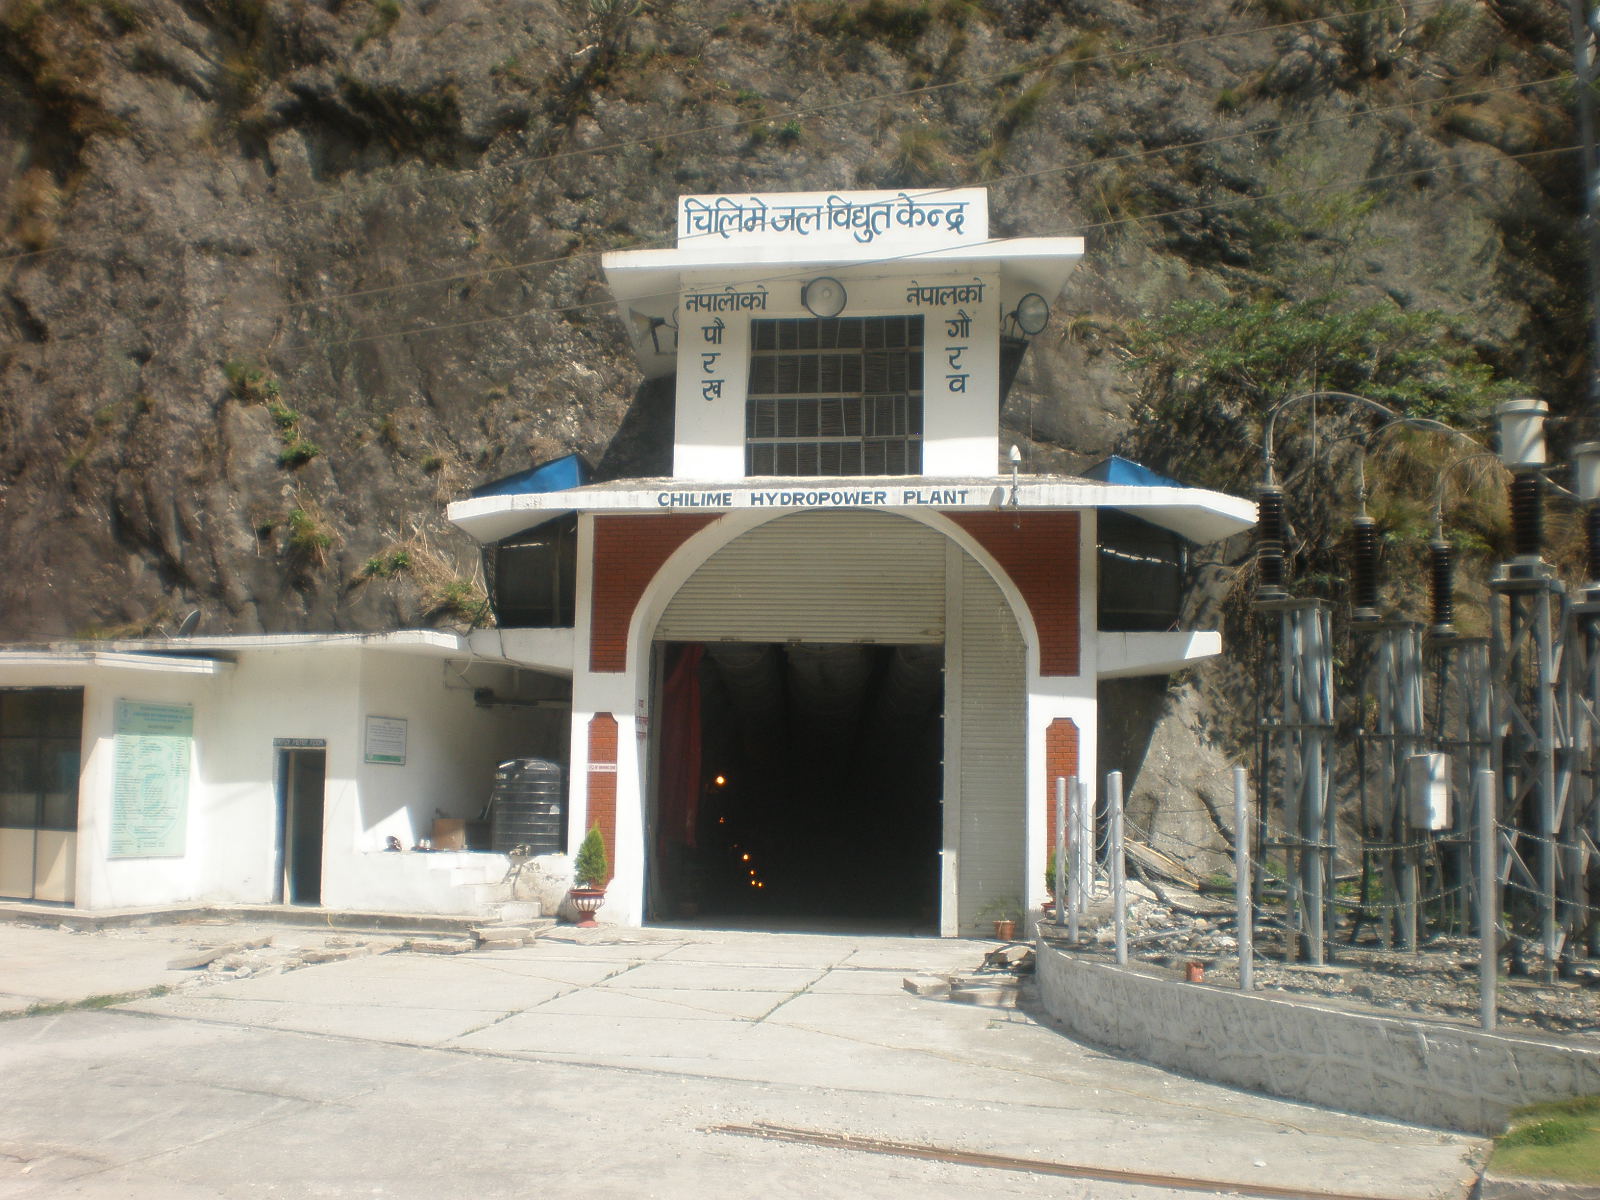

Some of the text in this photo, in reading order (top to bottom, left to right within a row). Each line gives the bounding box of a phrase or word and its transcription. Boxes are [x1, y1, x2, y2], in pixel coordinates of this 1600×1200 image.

[684, 197, 768, 239] चिलिमे
[771, 205, 824, 235] जल
[896, 192, 970, 235] केन्द्र
[906, 277, 986, 306] नेपालको
[657, 489, 969, 507] CHILIME HYDROPOWER PLANT
